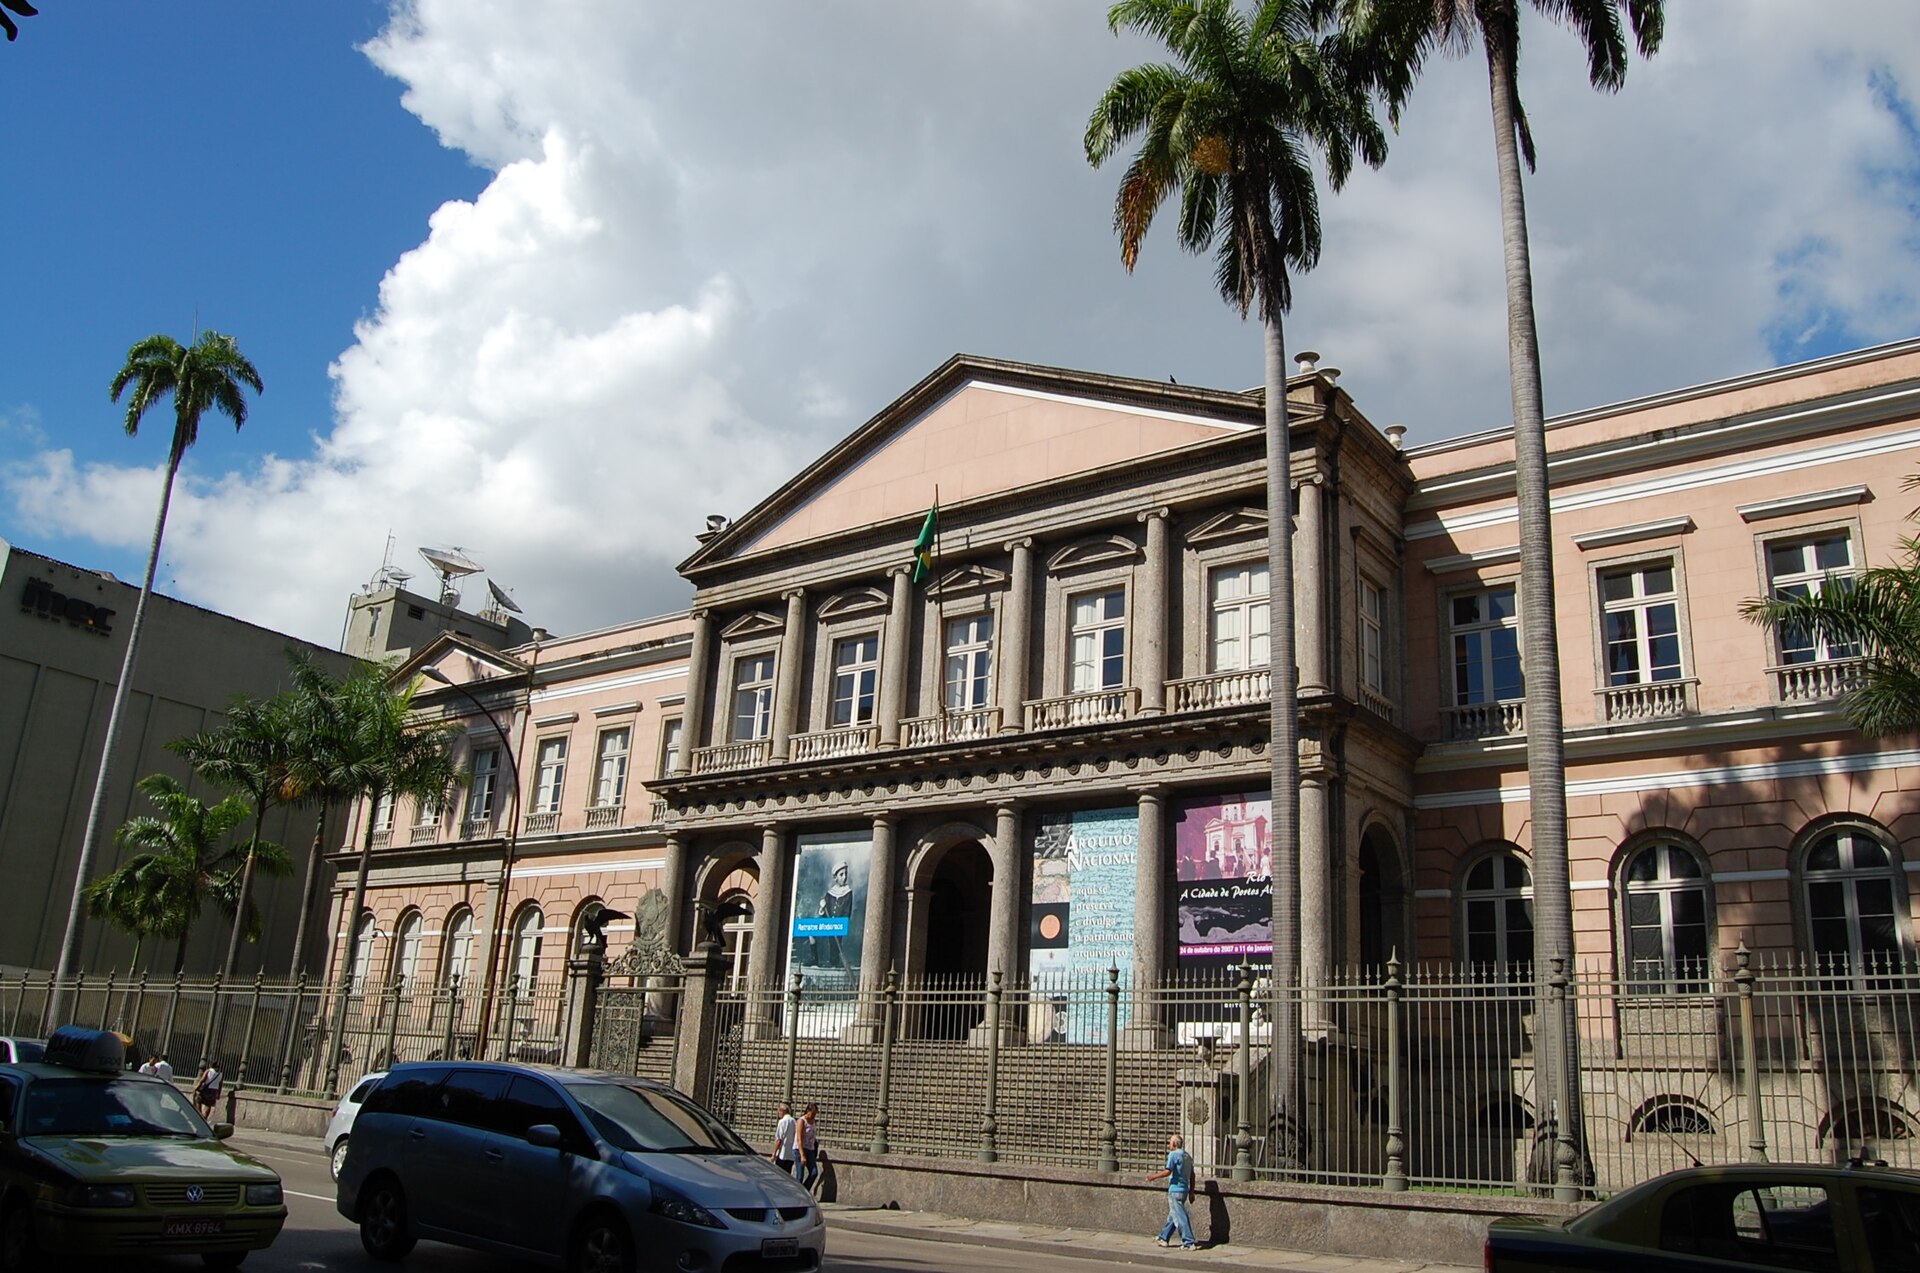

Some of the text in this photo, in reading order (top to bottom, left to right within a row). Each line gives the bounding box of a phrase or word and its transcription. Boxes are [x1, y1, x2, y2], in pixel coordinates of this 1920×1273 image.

[1064, 834, 1132, 856] ARQUIVO
[1067, 852, 1135, 872] NACIONAL
[1246, 871, 1266, 884] Rio
[1076, 886, 1096, 898] aqui
[1179, 889, 1189, 902] A
[1190, 887, 1219, 898] Cidade
[1220, 887, 1230, 897] de
[1076, 901, 1115, 913] preserva
[1082, 916, 1116, 928] divulga
[1083, 931, 1135, 944] patrimônio
